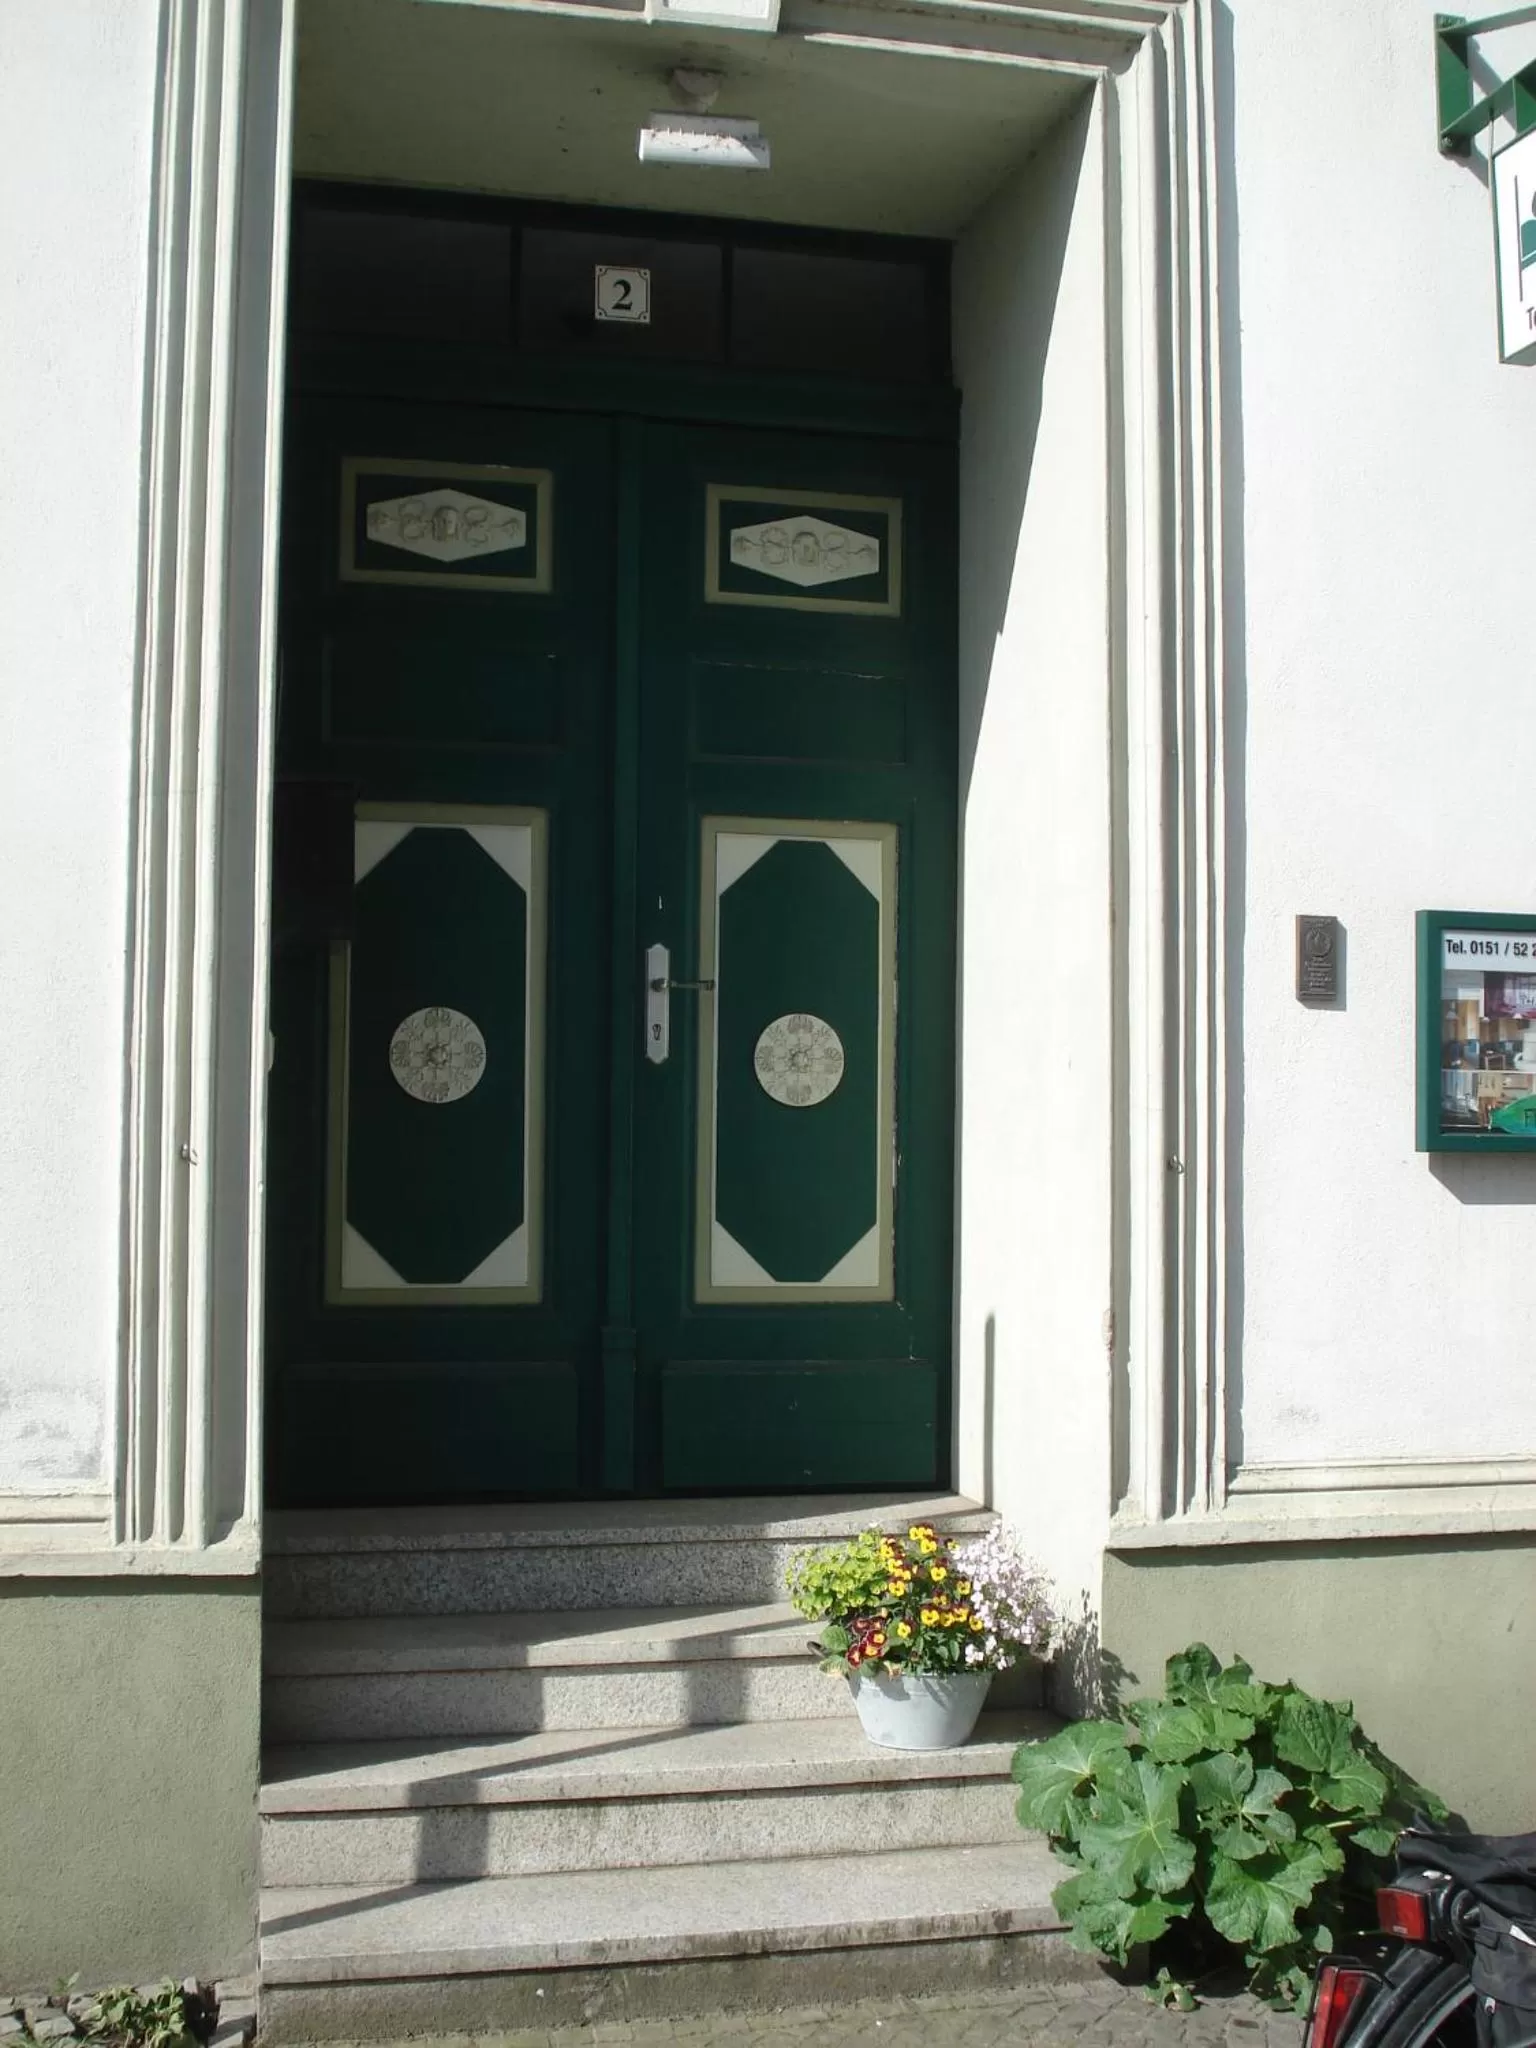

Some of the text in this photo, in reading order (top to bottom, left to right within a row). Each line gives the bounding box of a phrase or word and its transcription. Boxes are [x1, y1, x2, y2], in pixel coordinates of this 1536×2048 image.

[611, 279, 633, 311] 2
[1446, 939, 1467, 954] Tel.
[1470, 940, 1499, 955] 0151
[1504, 941, 1509, 956] /
[1513, 942, 1528, 956] 52
